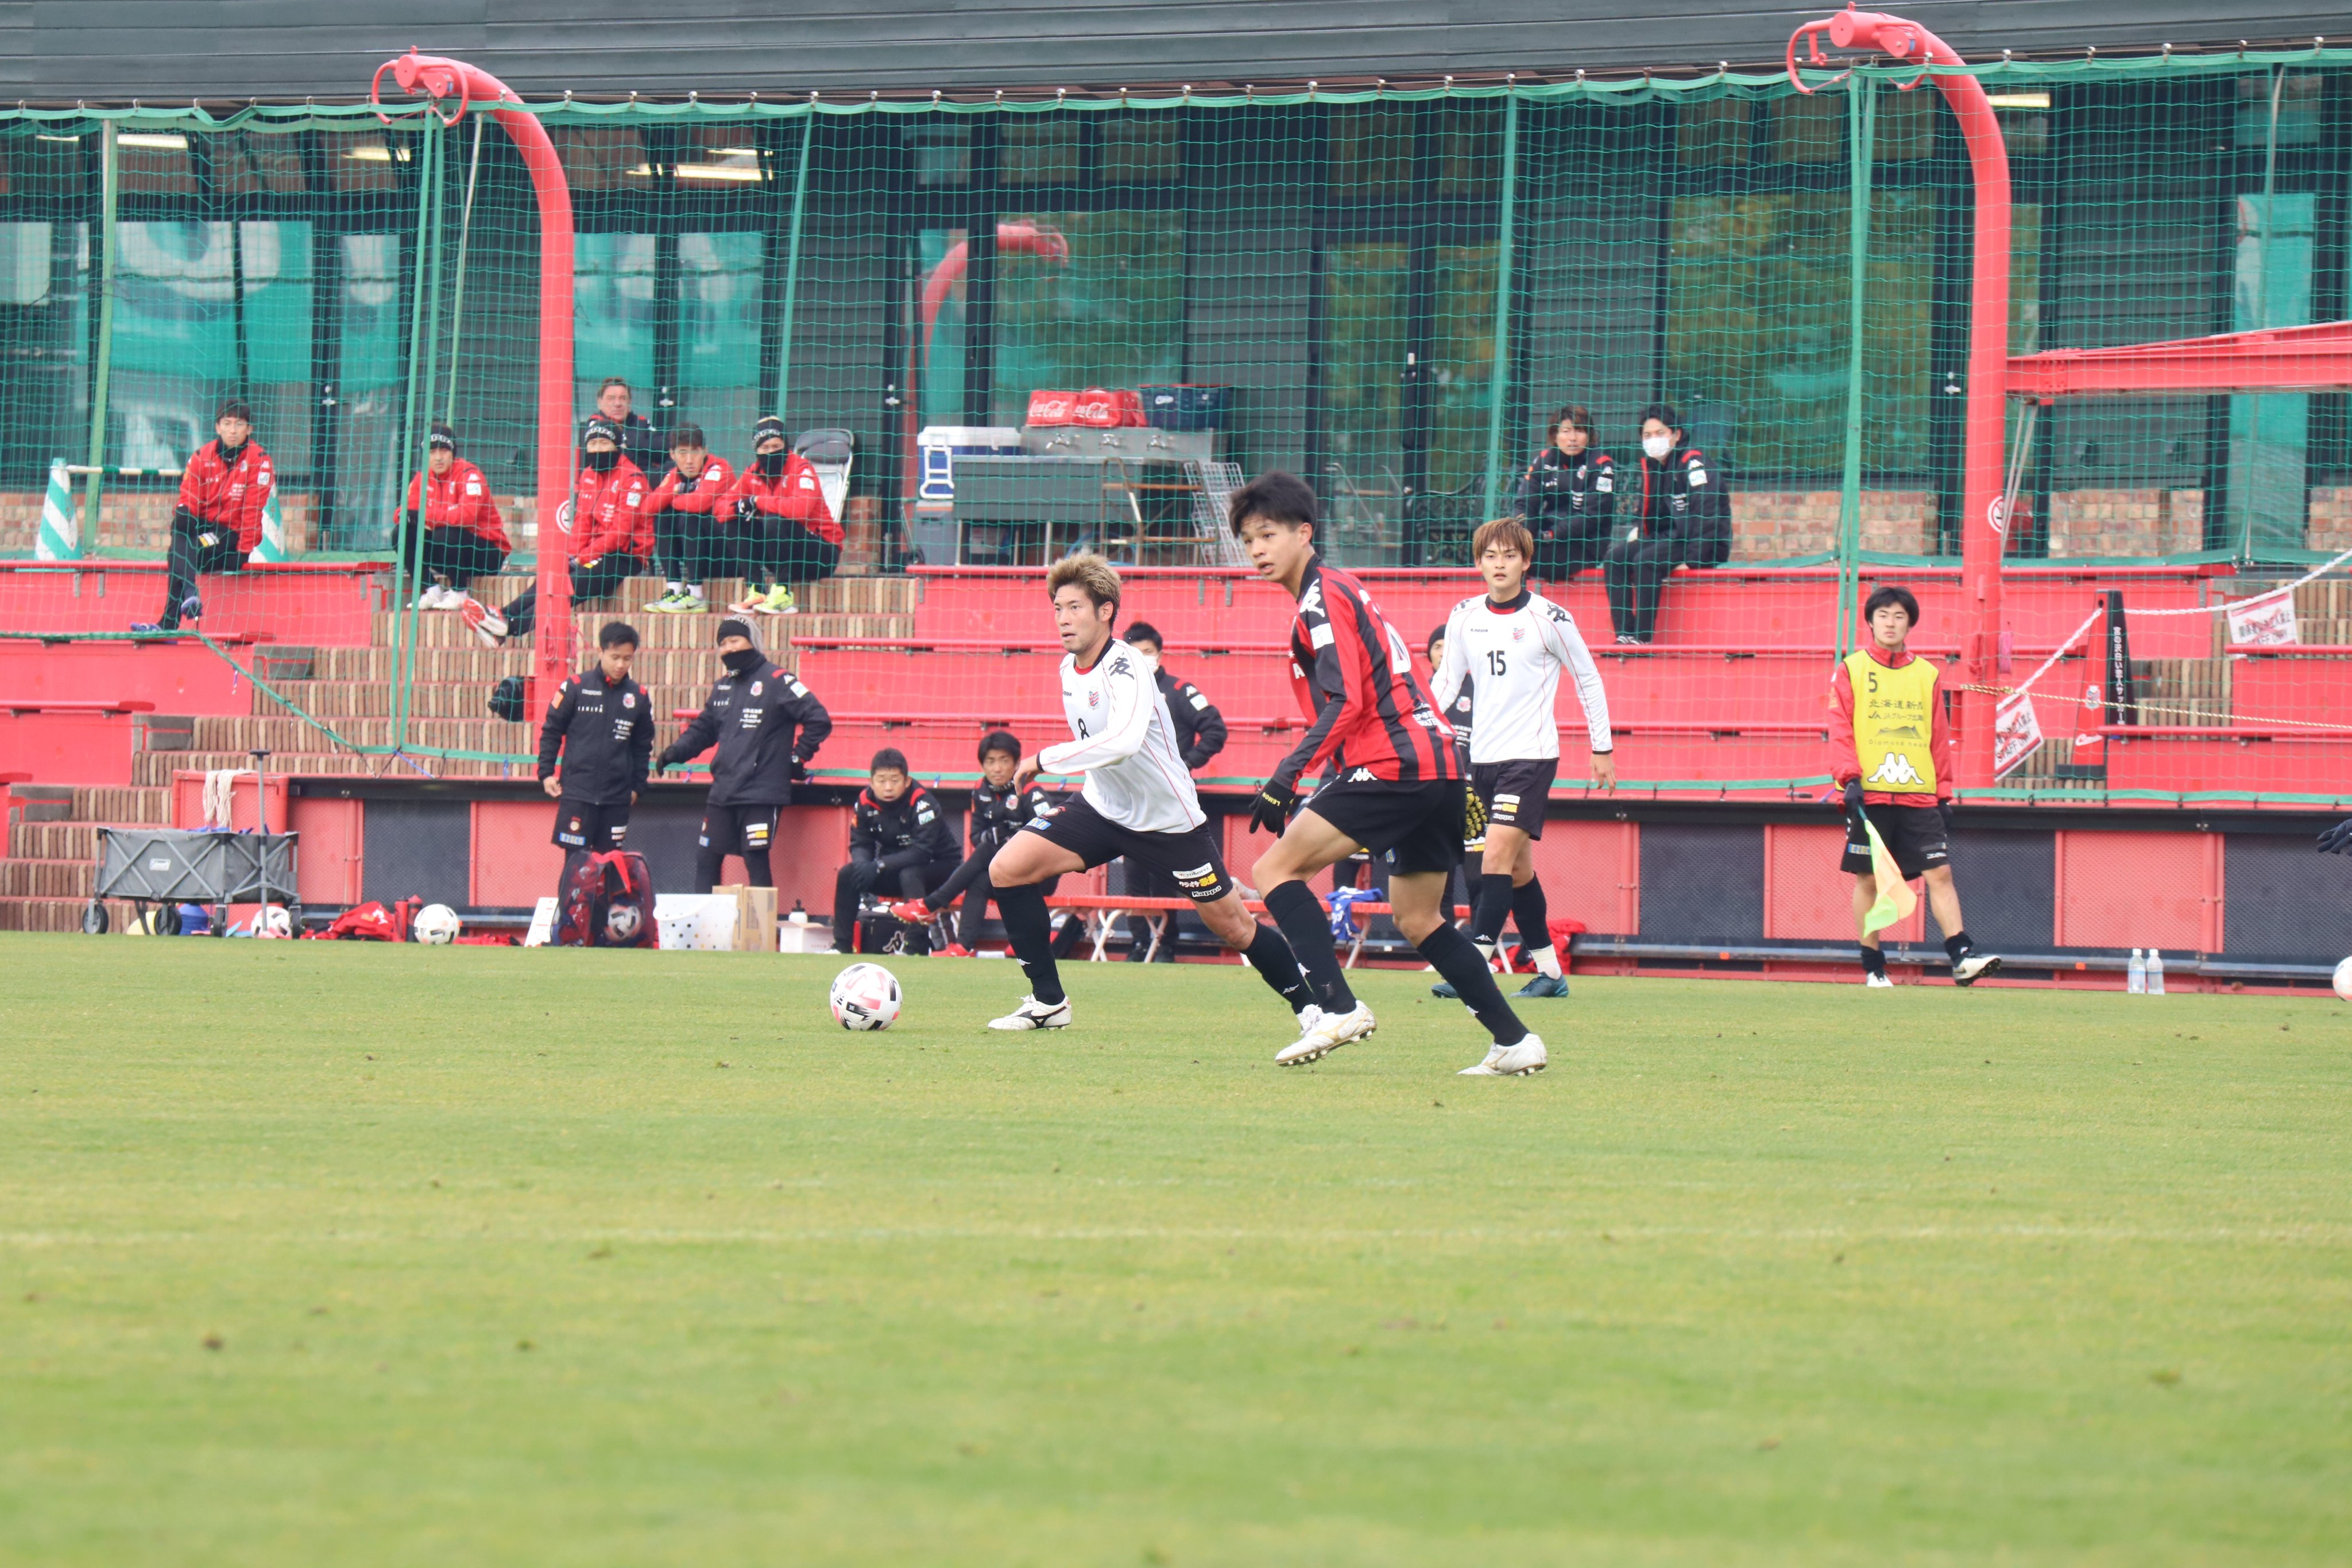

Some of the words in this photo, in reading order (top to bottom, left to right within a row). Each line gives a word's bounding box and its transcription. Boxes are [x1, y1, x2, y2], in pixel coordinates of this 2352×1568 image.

[1486, 650, 1506, 676] 15
[1868, 671, 1878, 693] 5
[1192, 885, 1222, 897] Kappa
